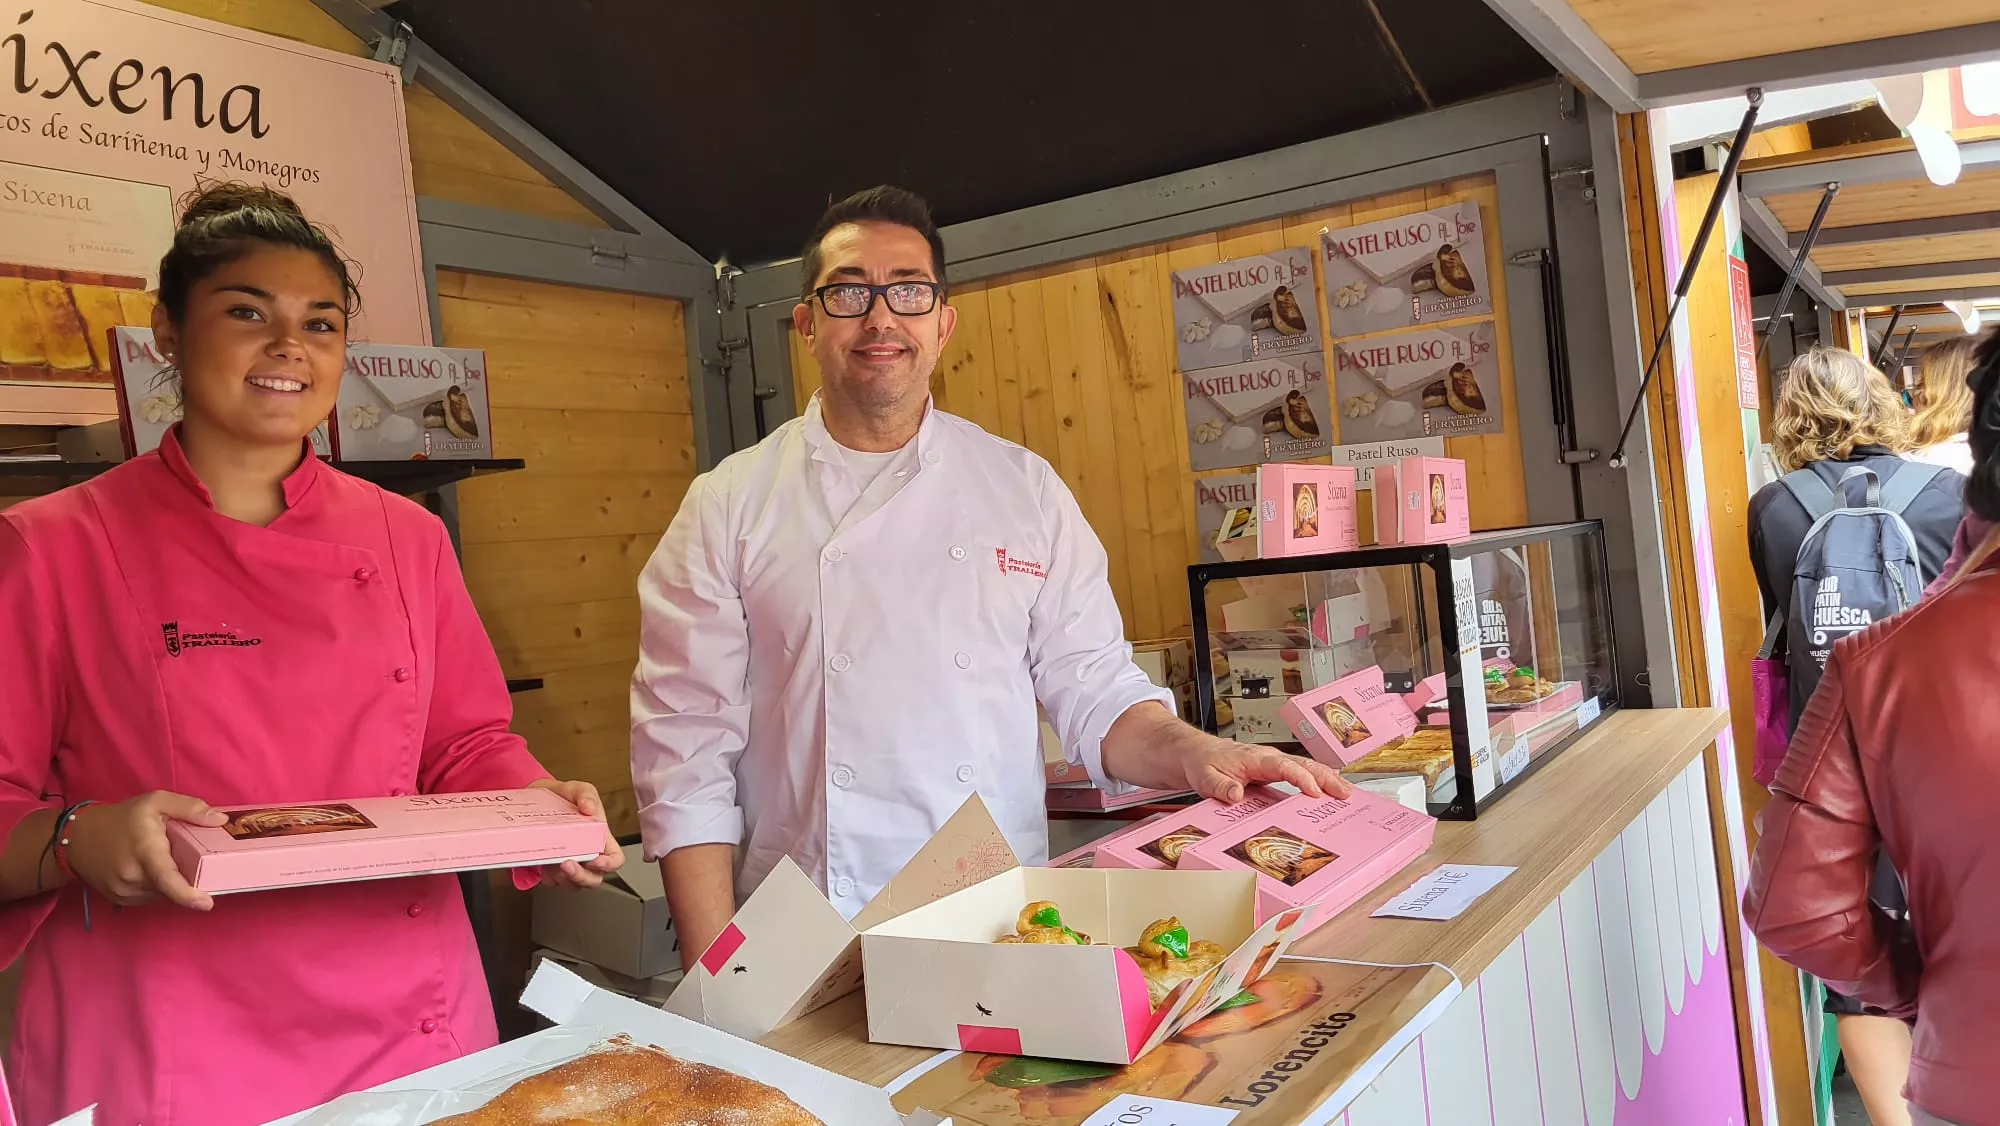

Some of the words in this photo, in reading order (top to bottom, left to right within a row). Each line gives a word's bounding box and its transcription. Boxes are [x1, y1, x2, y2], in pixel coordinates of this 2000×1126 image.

[0, 9, 270, 139] ixena
[42, 112, 69, 139] de
[196, 148, 211, 174] y
[218, 148, 320, 188] Monegros
[1327, 234, 1384, 261] PASTEL
[1385, 223, 1431, 249] RUSO
[1175, 274, 1227, 299] PASTEL
[1227, 265, 1269, 289] RUSO
[1262, 336, 1313, 349] TRALLERO
[344, 355, 396, 377] ASTEL
[398, 357, 442, 379] RUSO
[1338, 347, 1394, 371] PASTEL
[1397, 339, 1444, 363] RUSO
[1187, 376, 1238, 399] PASTEL
[1239, 368, 1281, 391] RUSO
[1435, 416, 1493, 429] TRALLERO
[1348, 446, 1382, 461] Pastel
[1387, 446, 1419, 458] Ruso
[1200, 484, 1250, 505] PASTEL
[1815, 592, 1841, 607] PATIN
[1814, 606, 1872, 626] HUESCA
[181, 638, 262, 648] TRALLERO
[1220, 1012, 1357, 1108] Lorencito
